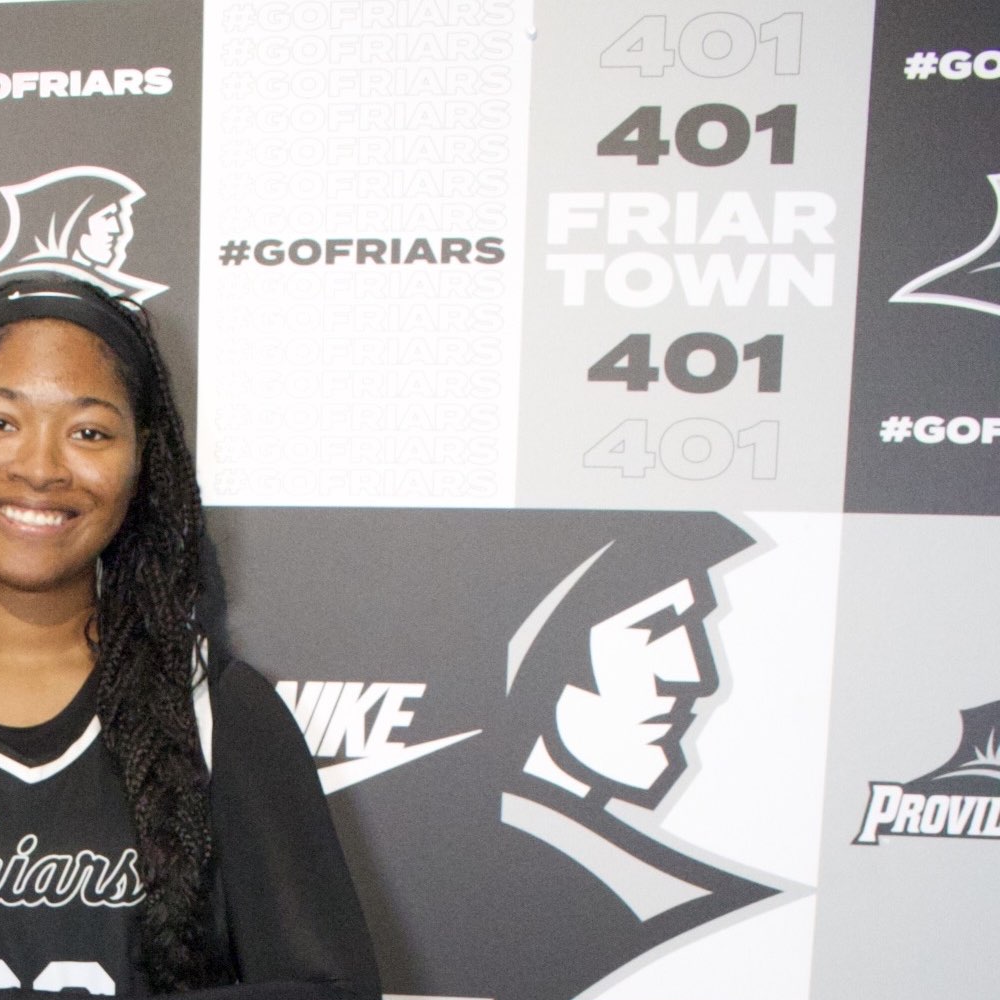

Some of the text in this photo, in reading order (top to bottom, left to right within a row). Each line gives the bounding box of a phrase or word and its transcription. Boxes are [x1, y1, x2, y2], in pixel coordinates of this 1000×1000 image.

[600, 11, 804, 78] 401
[596, 103, 797, 167] 401
[546, 191, 837, 246] FRIAR
[218, 237, 506, 266] #GOFRIARS
[546, 251, 835, 308] TOWN
[587, 331, 784, 394] 401
[583, 417, 780, 481] 401
